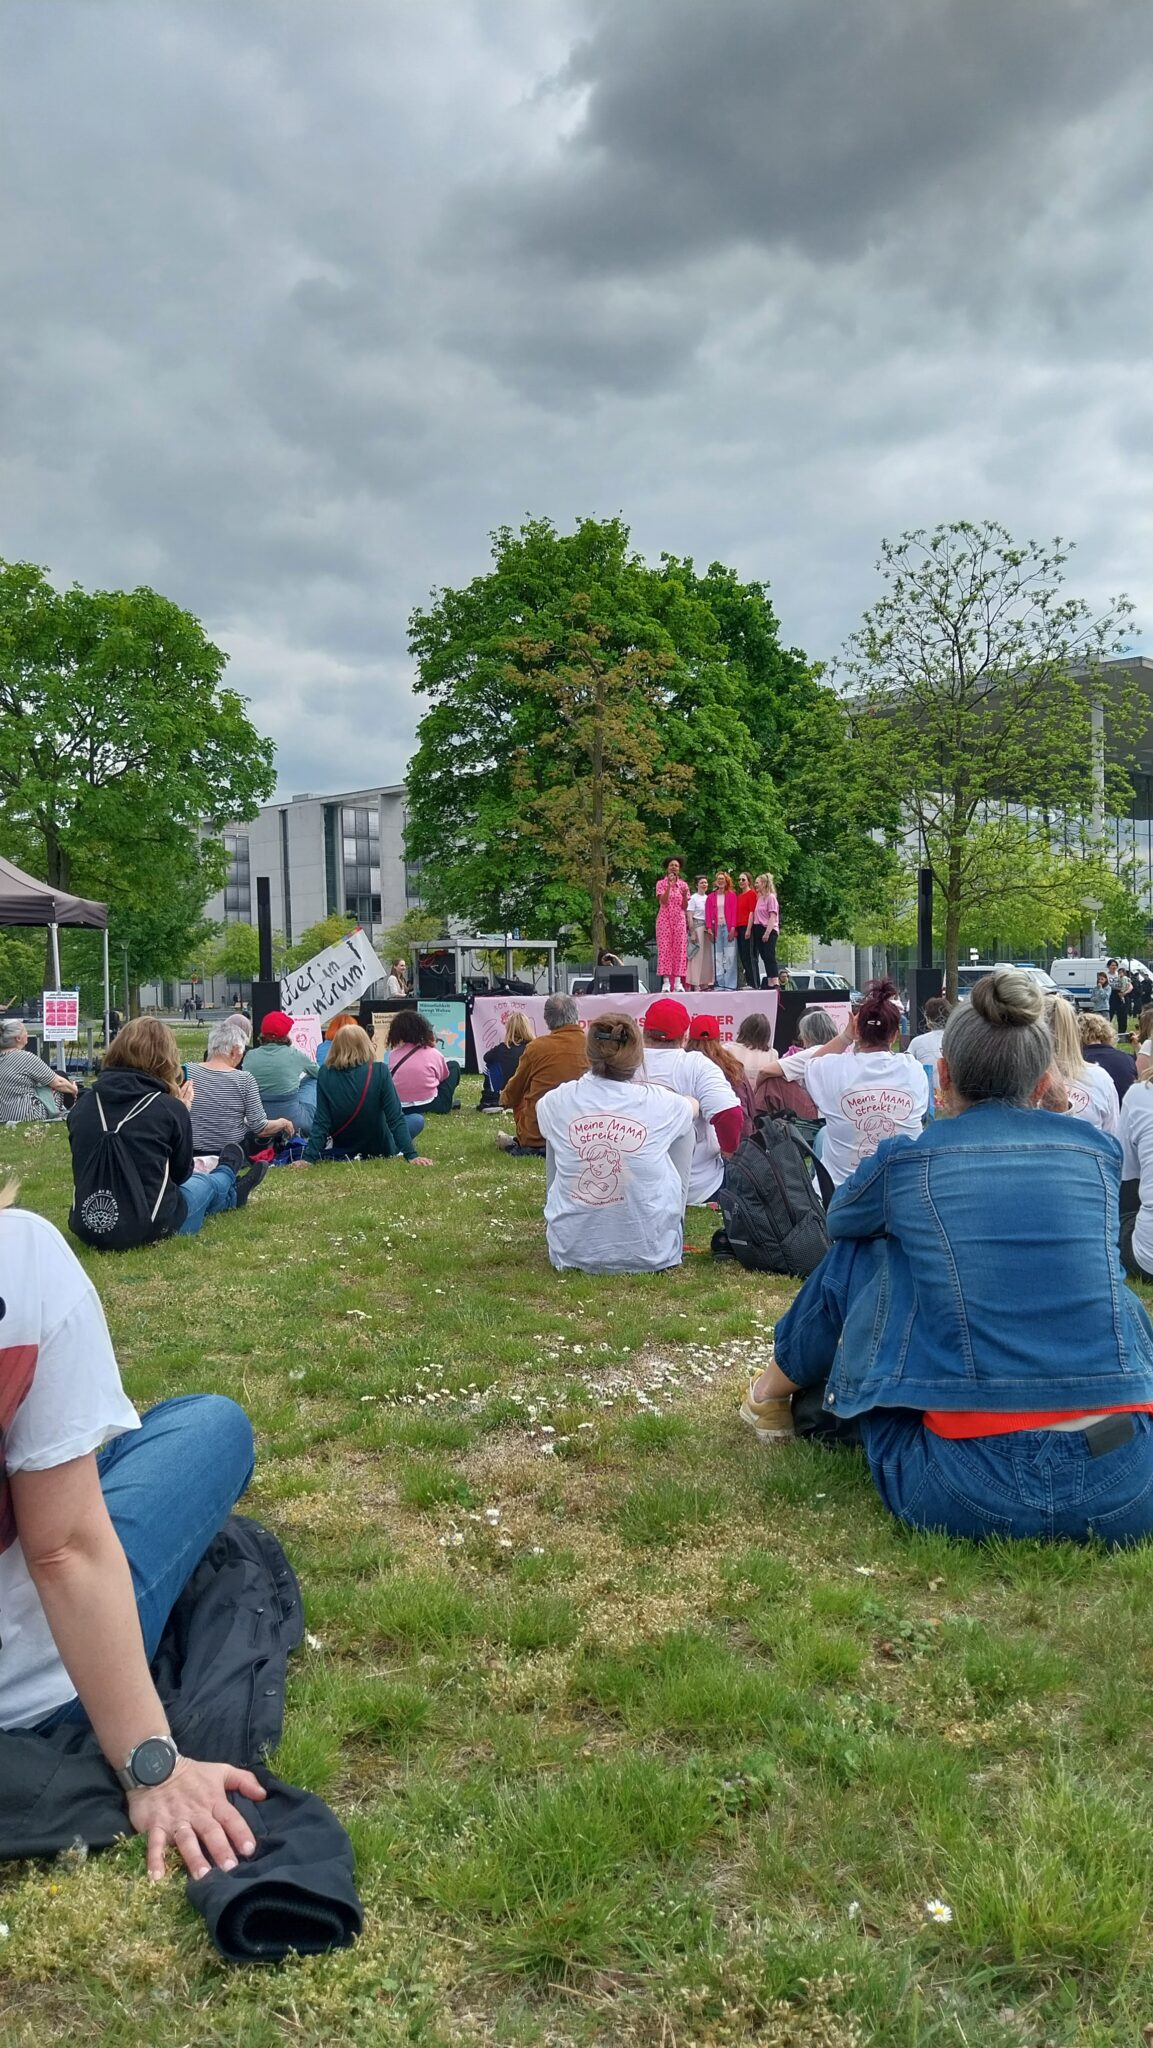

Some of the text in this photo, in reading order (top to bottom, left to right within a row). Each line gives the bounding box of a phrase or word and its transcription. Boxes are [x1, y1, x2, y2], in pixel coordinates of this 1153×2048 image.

[281, 966, 315, 1010] tter
[846, 1091, 911, 1109] Meine MAMA
[855, 1103, 896, 1117] streikt!
[574, 1119, 643, 1140] Meine MAMA
[580, 1131, 625, 1146] streikt!
